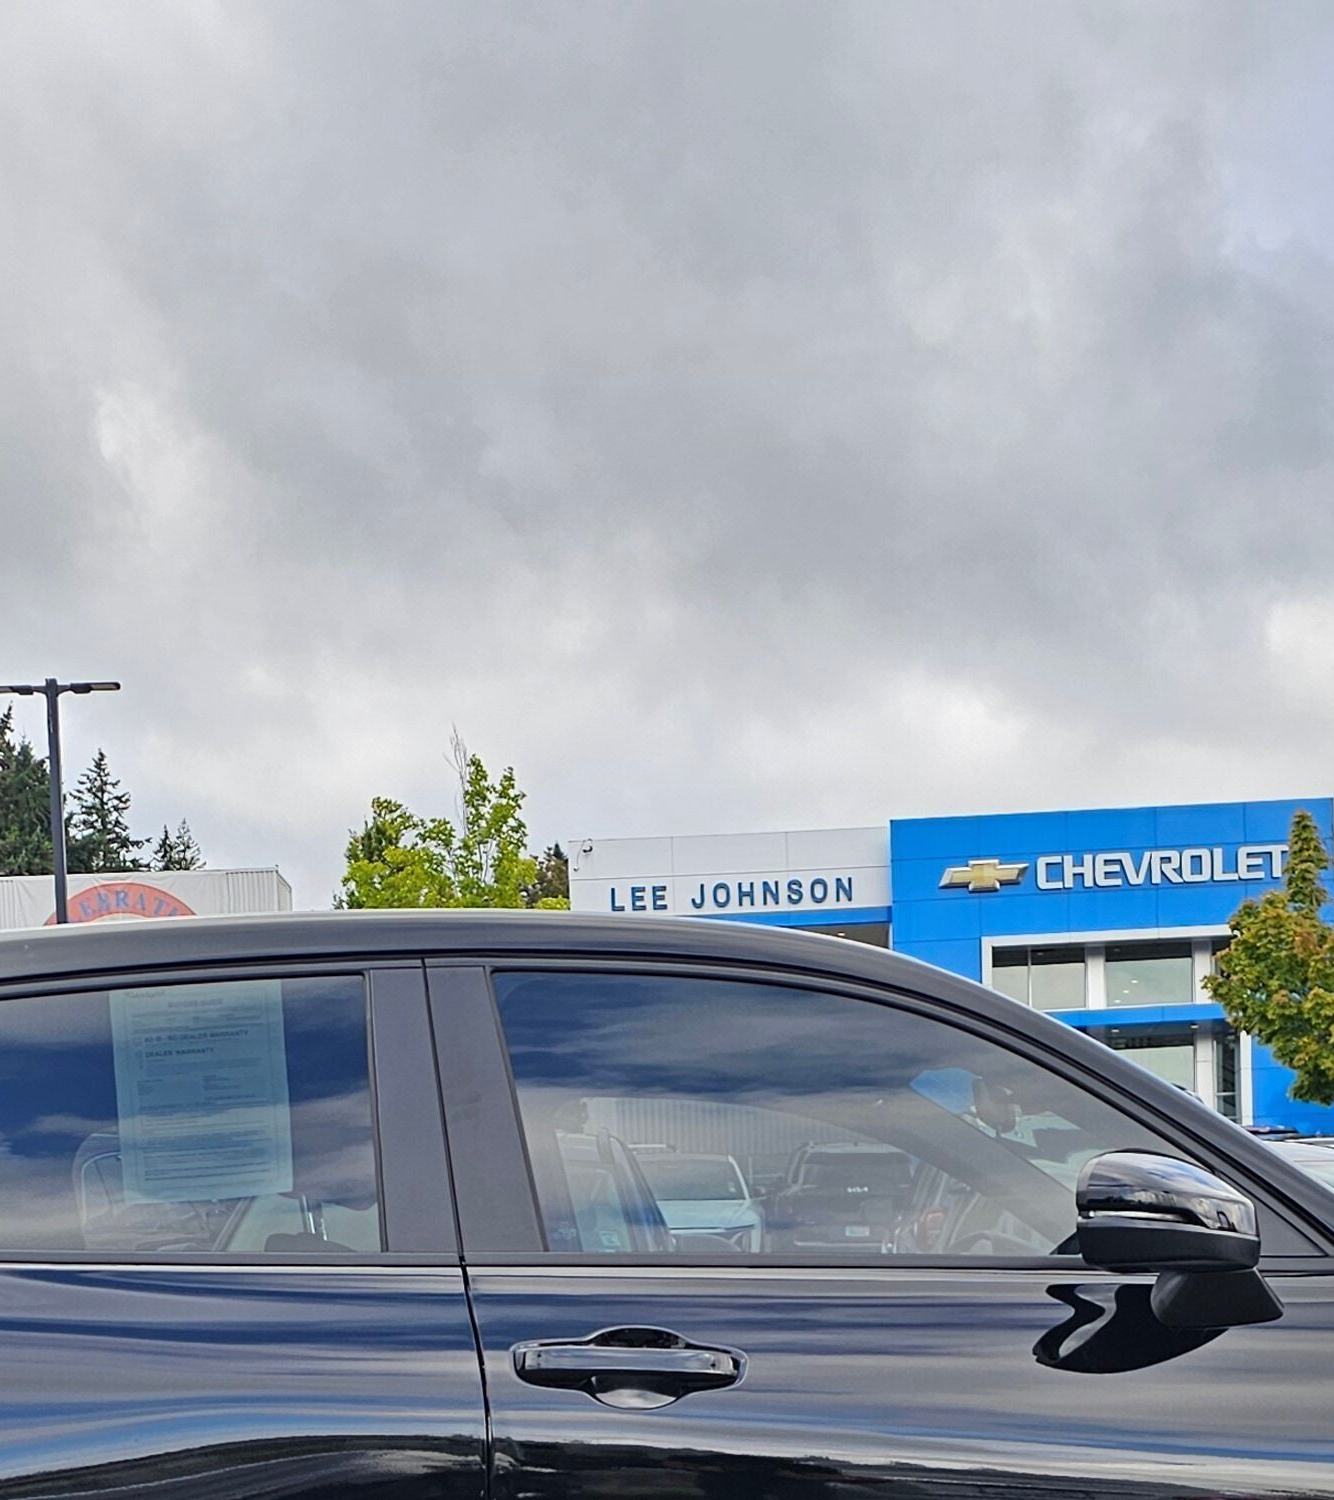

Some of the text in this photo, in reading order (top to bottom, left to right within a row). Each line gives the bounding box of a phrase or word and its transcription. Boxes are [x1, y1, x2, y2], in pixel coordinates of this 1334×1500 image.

[1036, 844, 1289, 890] CHEVROLET
[610, 876, 854, 912] LEE JOHNSON
